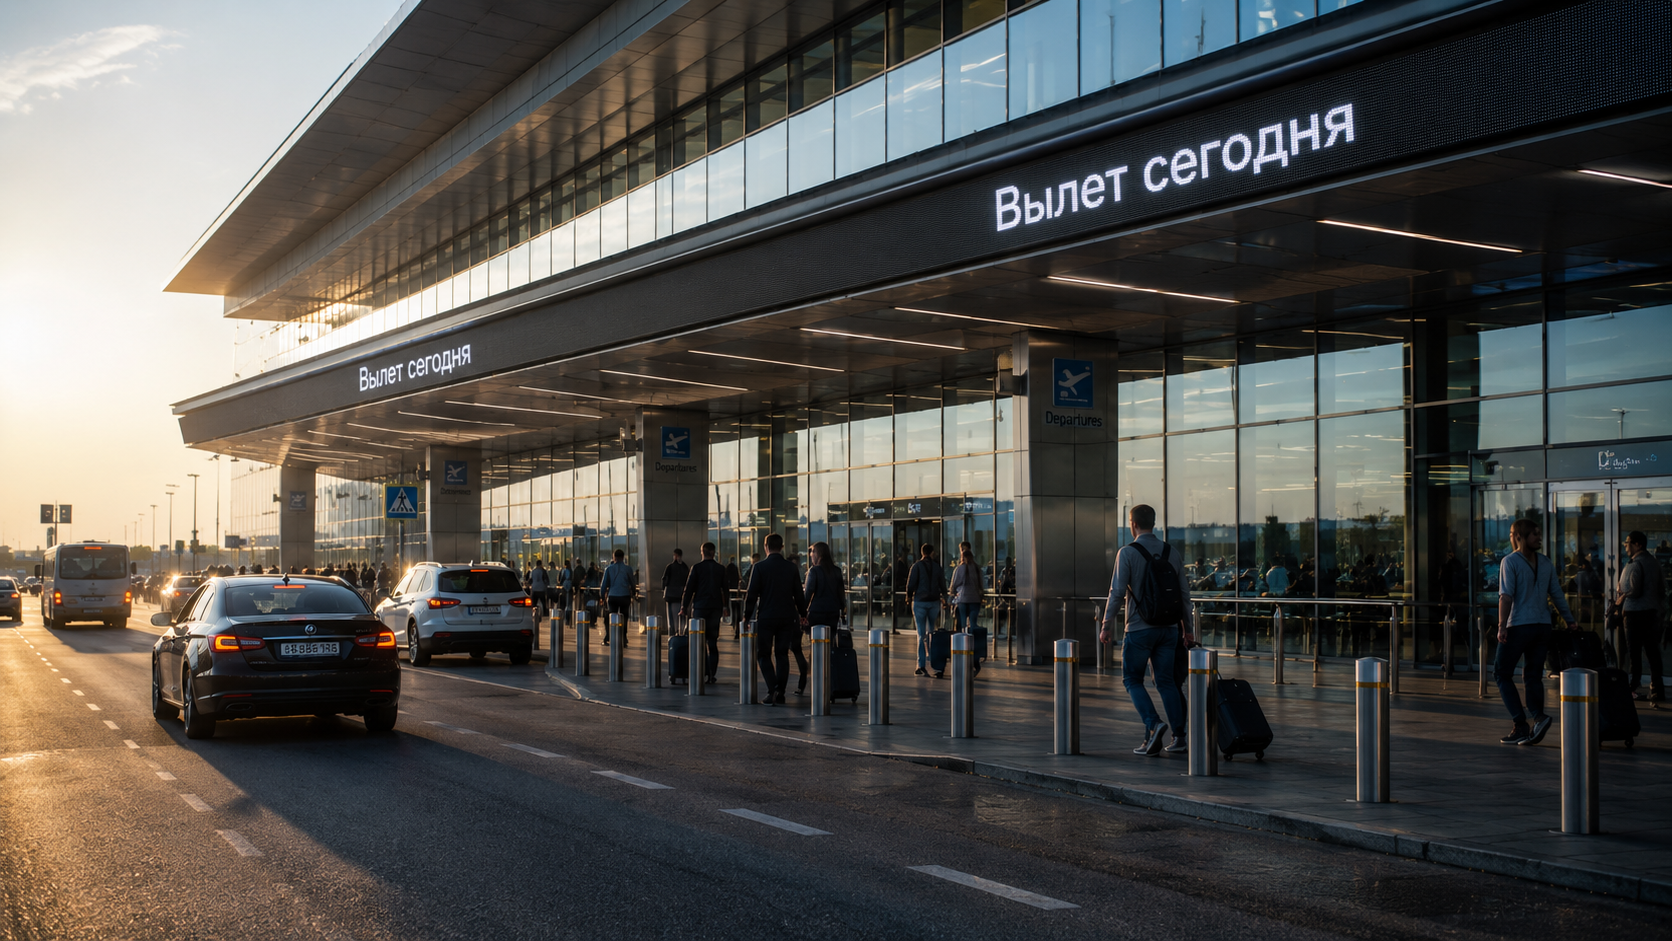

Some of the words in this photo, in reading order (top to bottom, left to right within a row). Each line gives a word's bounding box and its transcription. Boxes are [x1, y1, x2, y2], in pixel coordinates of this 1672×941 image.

[995, 165, 1128, 232] Вылет
[1143, 103, 1355, 192] сегодня
[359, 363, 404, 392] Вылет
[408, 344, 471, 379] сегодня
[1045, 411, 1103, 427] Departures
